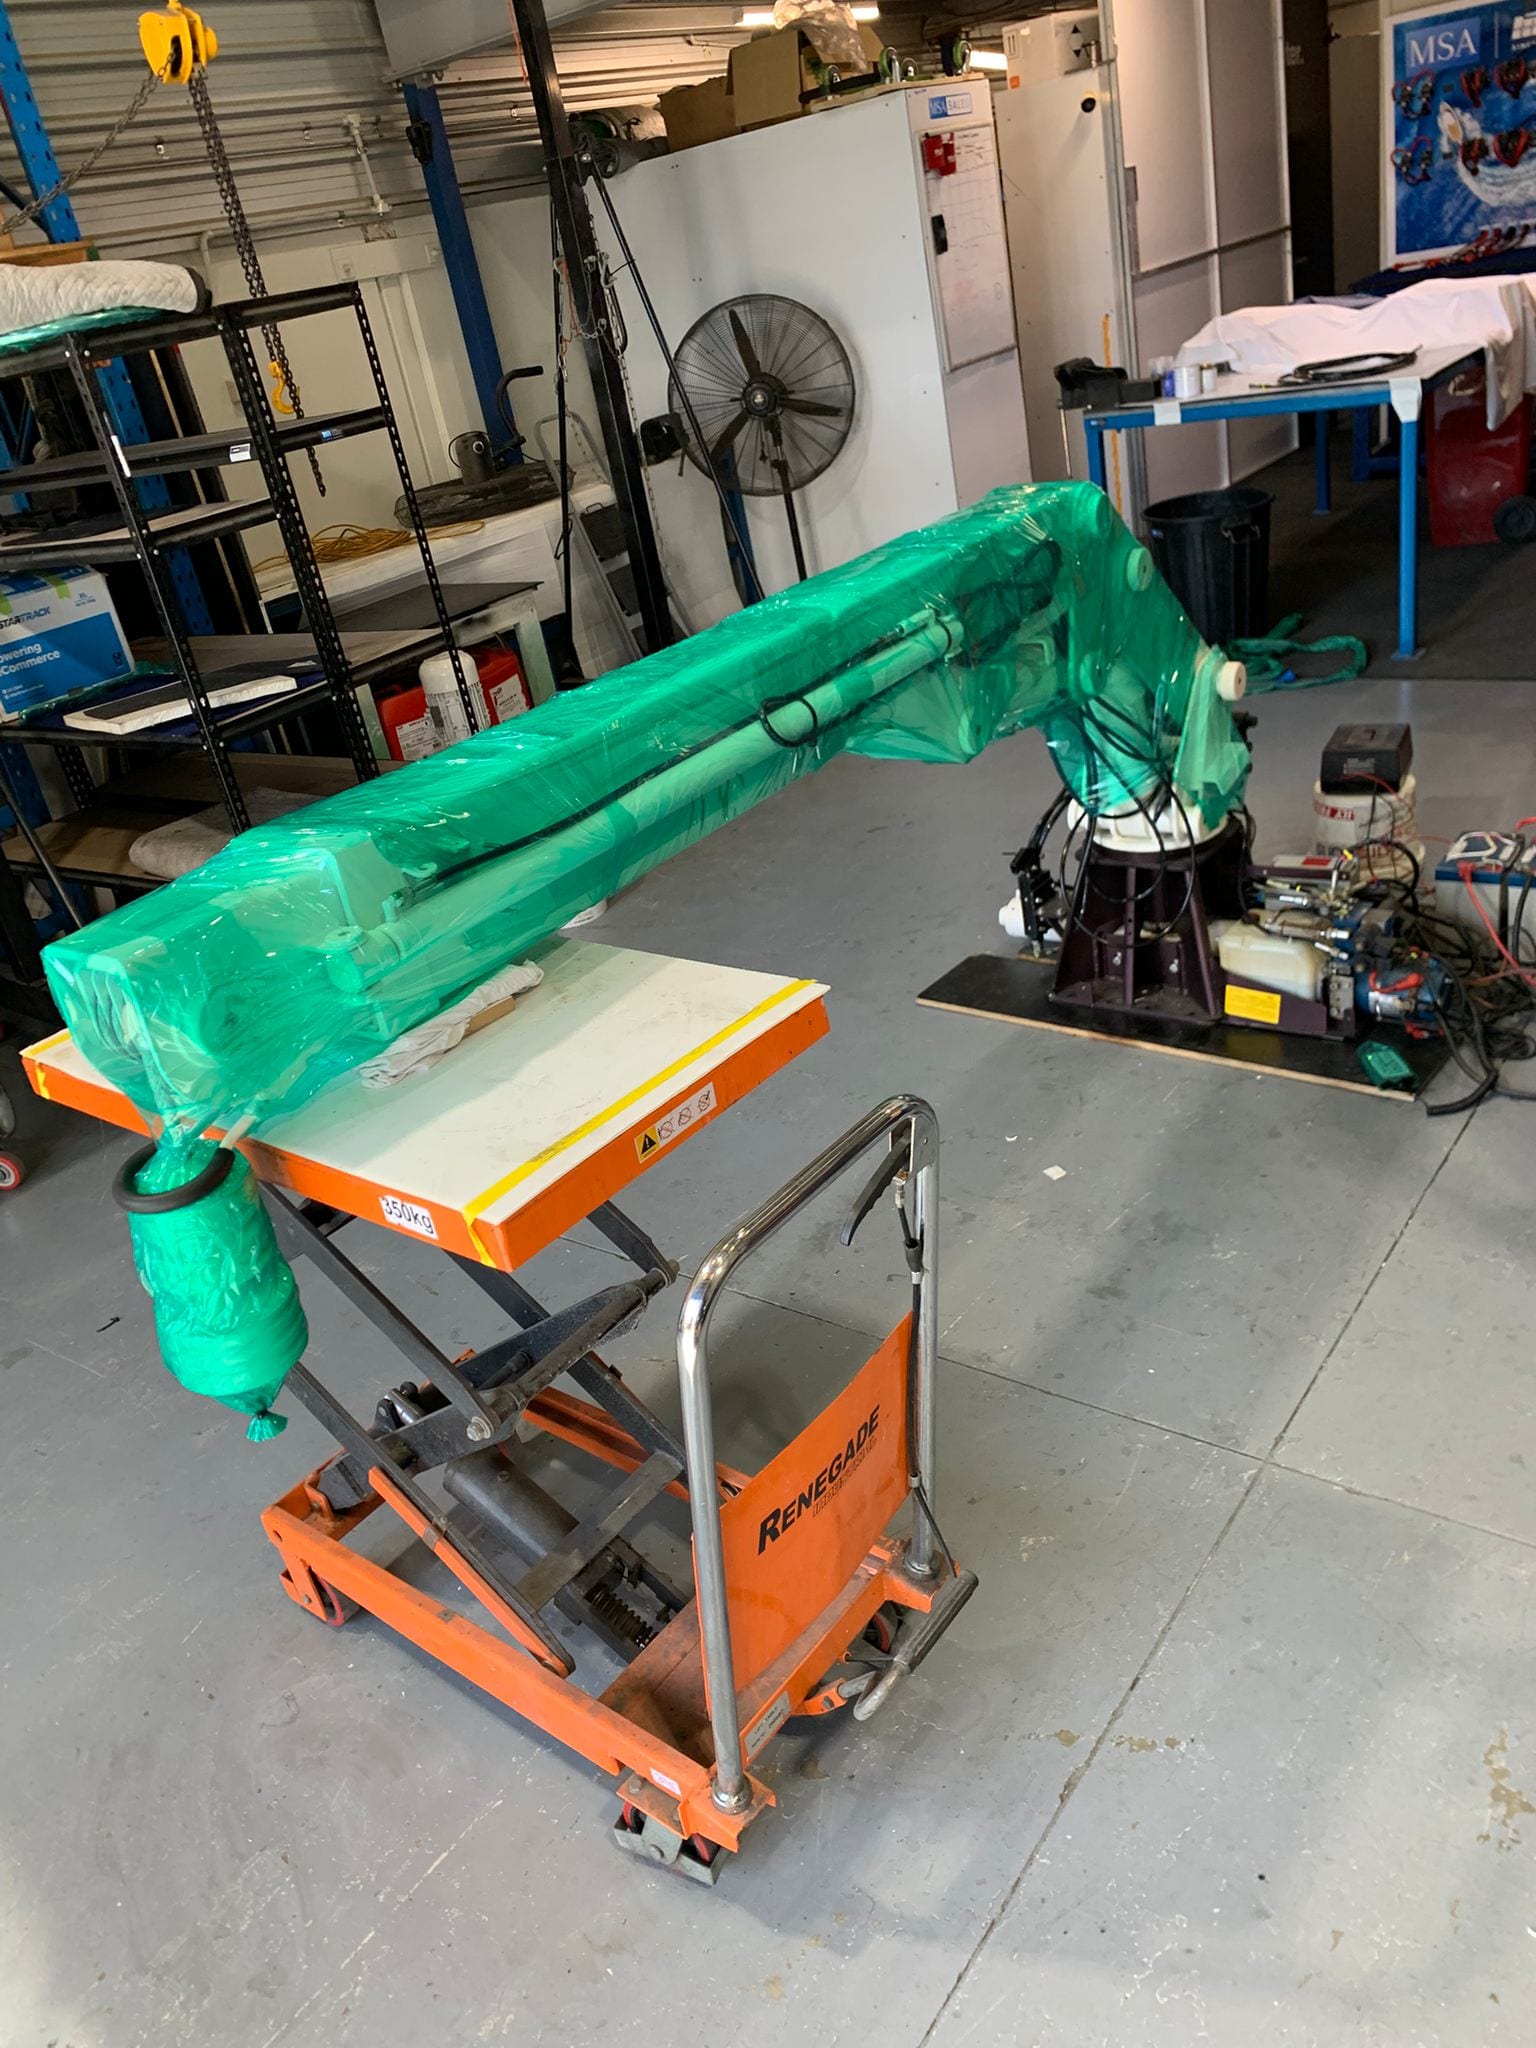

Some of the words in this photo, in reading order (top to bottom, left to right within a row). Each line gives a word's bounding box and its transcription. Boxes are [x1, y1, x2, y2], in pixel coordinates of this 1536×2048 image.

[1410, 28, 1478, 67] MSA
[0, 607, 51, 629] STARTRACK
[0, 643, 42, 663] owering
[382, 1197, 434, 1234] 350kg
[758, 1404, 880, 1555] RENEGADE
